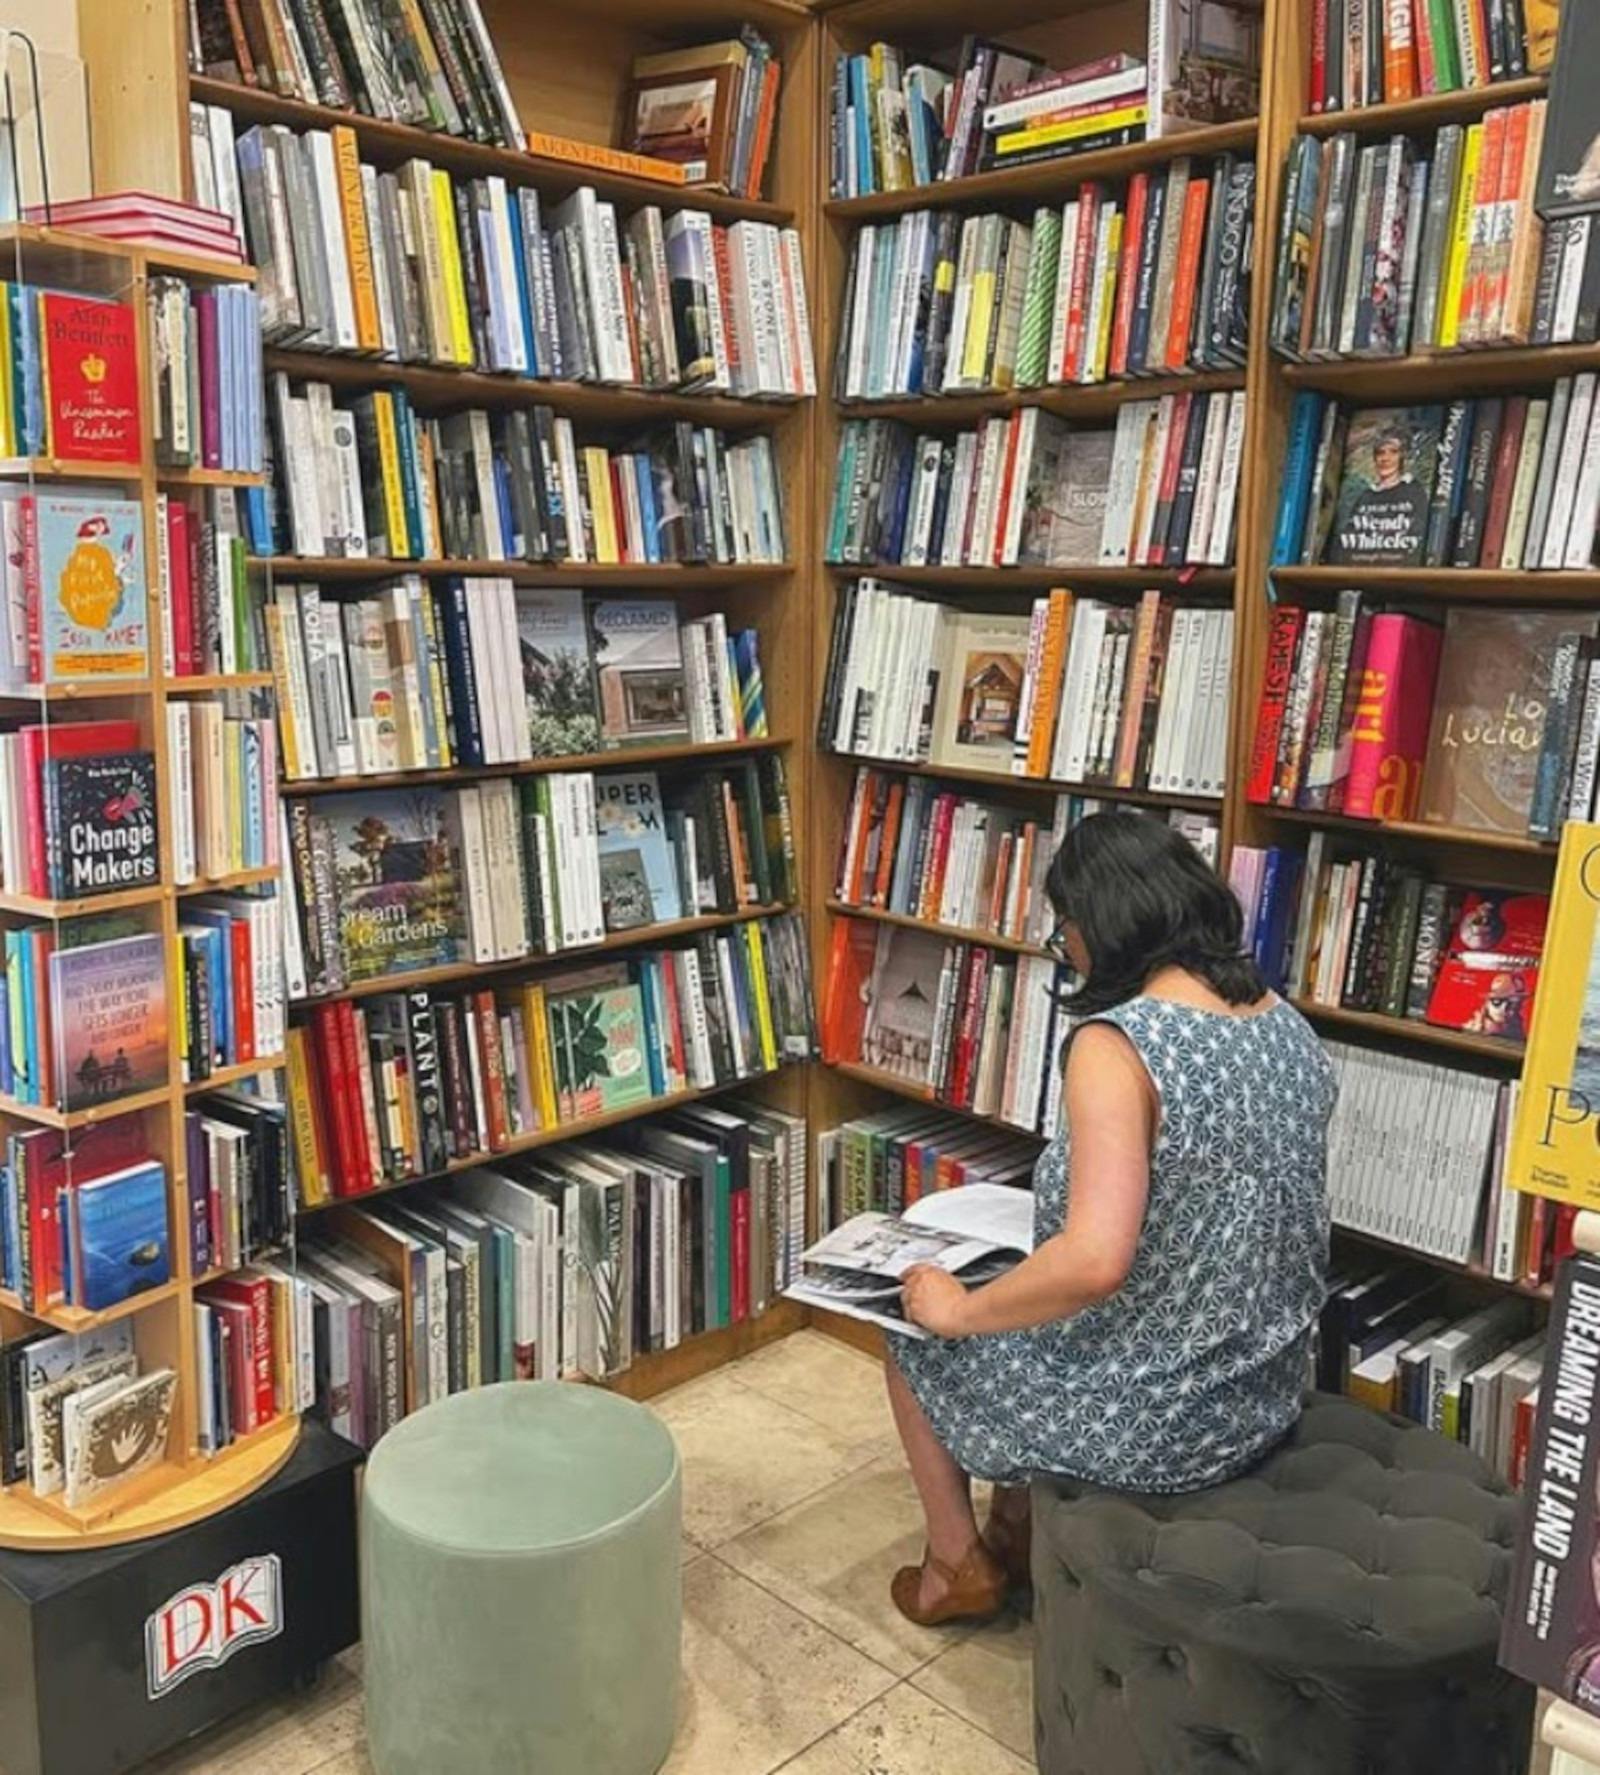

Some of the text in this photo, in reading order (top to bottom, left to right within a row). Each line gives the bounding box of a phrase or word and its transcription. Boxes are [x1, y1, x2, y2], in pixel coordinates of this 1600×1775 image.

[762, 278, 776, 335] STONE
[1341, 531, 1418, 554] Whiteley
[1353, 513, 1410, 535] Wendy
[1267, 610, 1296, 703] RAMESH
[70, 822, 154, 854] Change
[72, 853, 155, 887] Makers
[359, 919, 448, 946] Gardens
[410, 992, 437, 1088] PLANT
[1553, 1280, 1600, 1425] DREAMING
[1544, 1426, 1587, 1483] THE
[1533, 1478, 1579, 1561] LAND
[161, 1566, 269, 1676] DK
